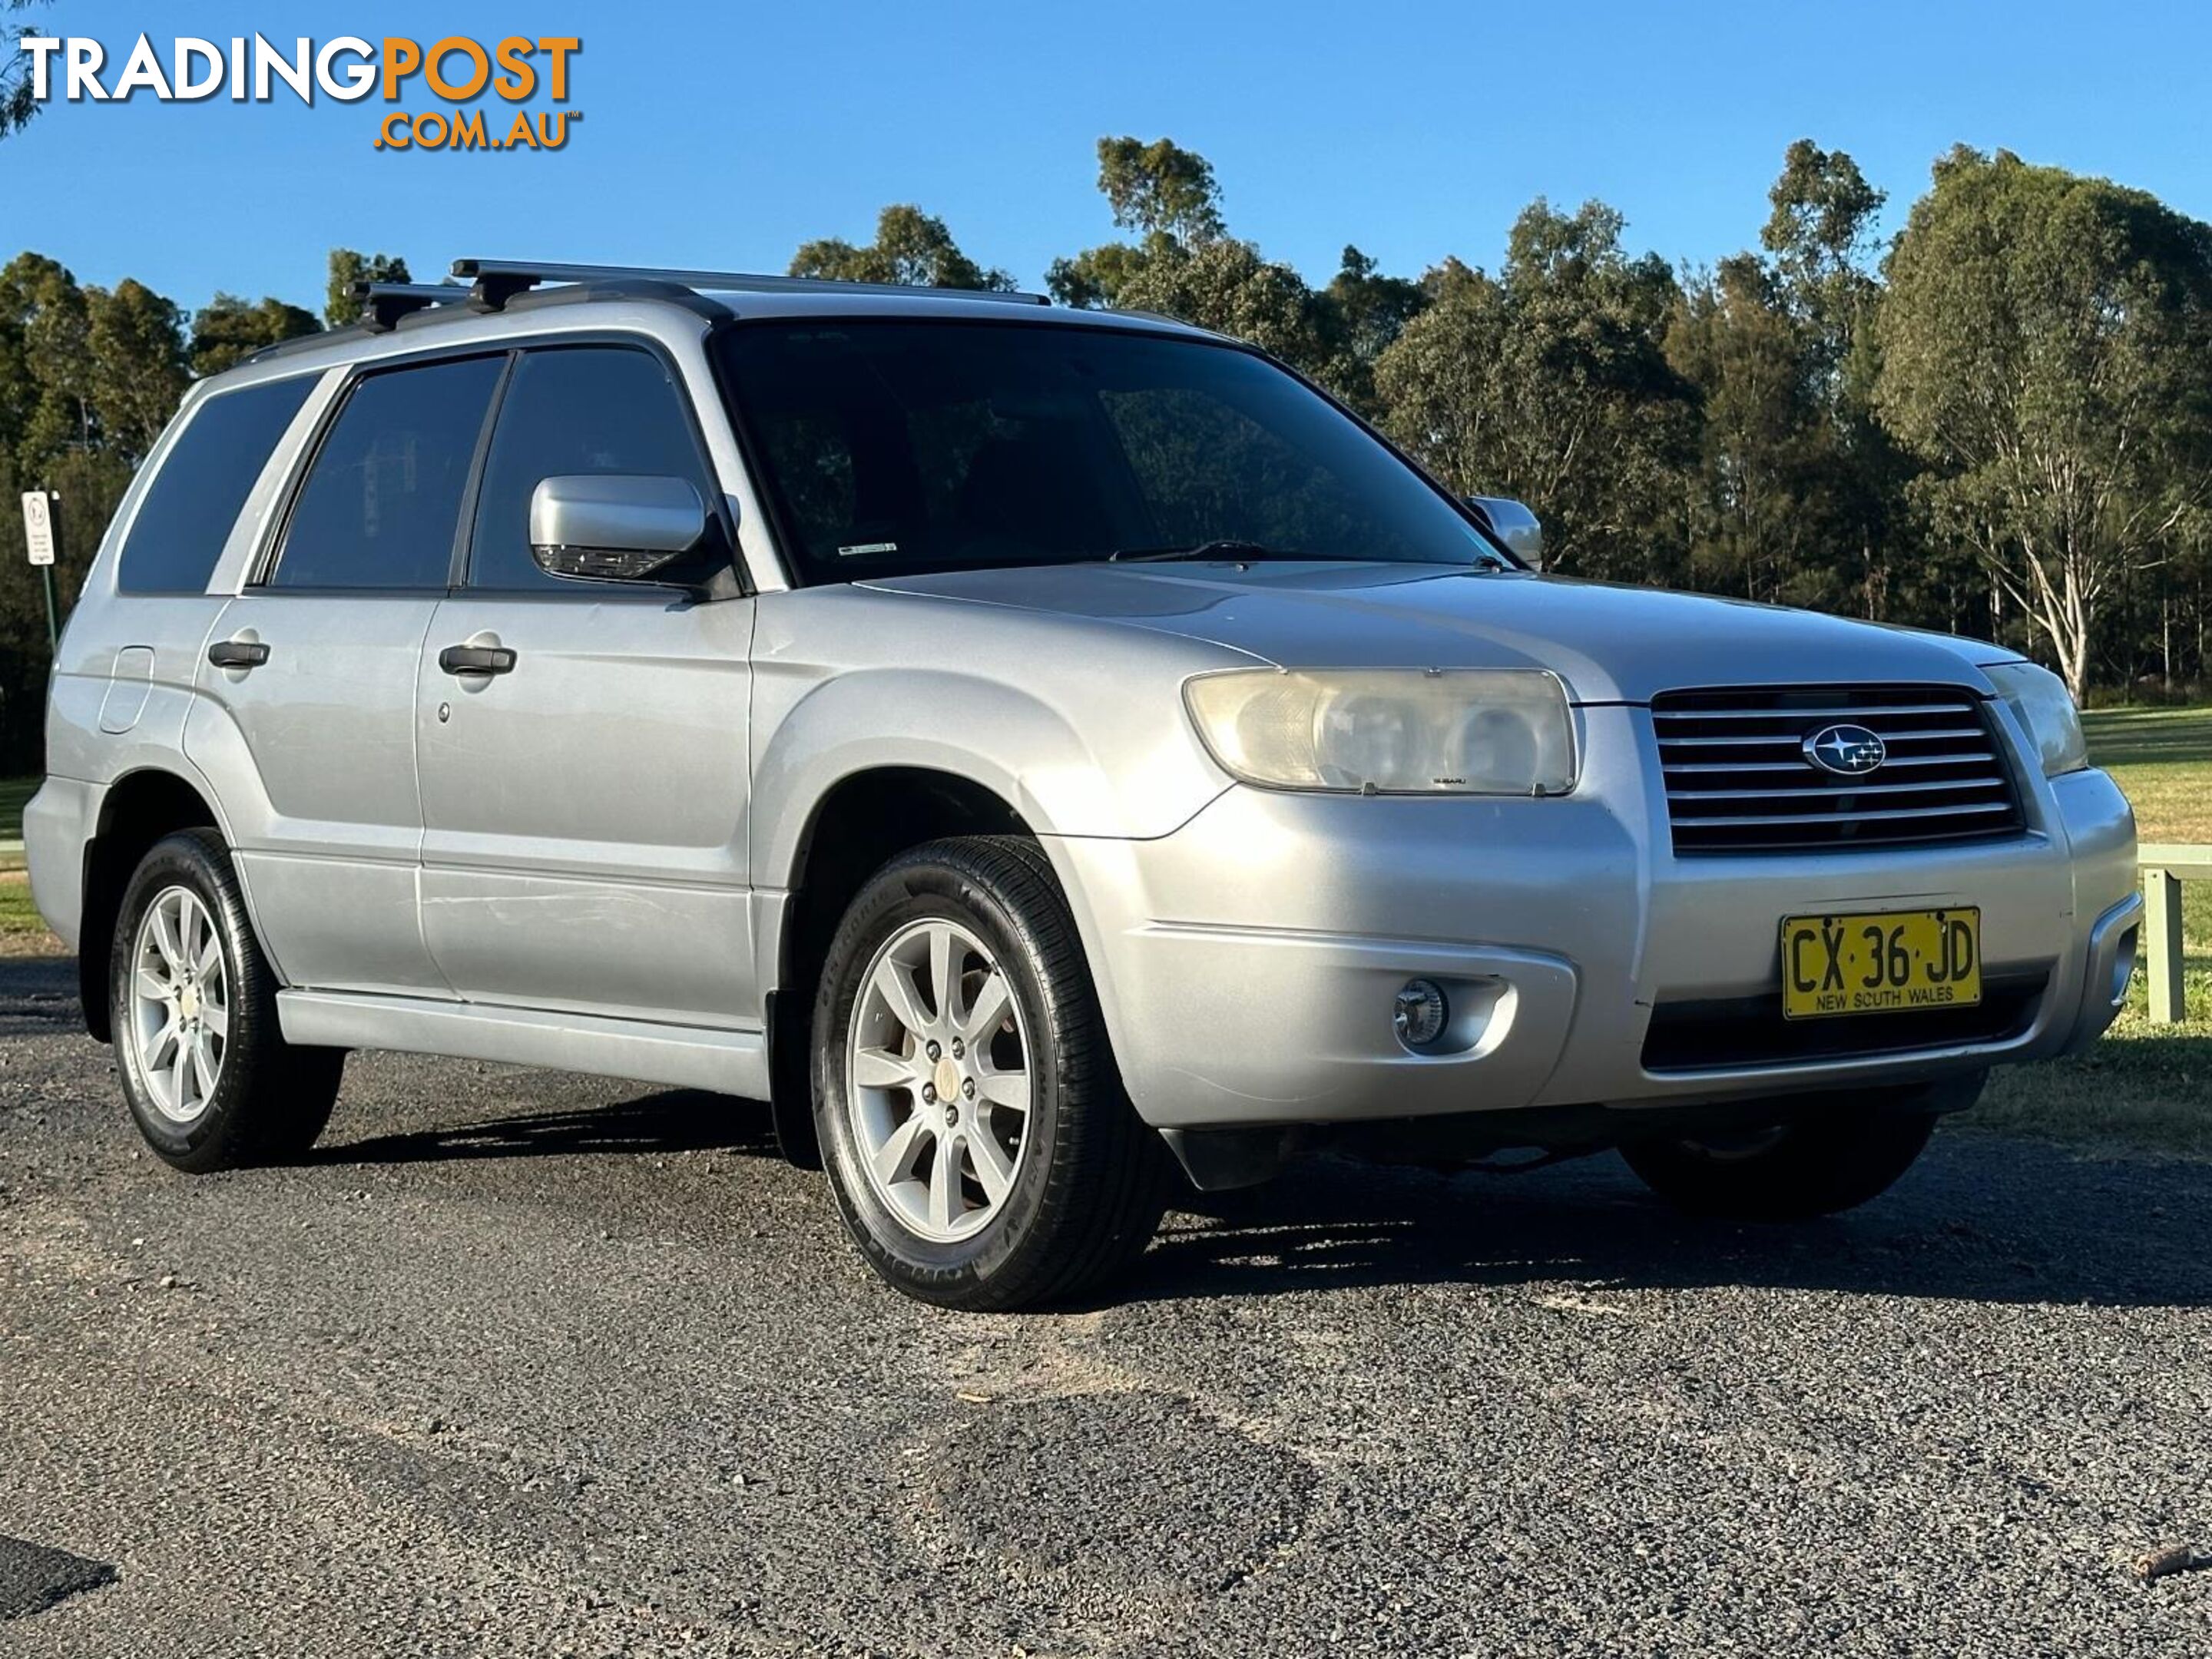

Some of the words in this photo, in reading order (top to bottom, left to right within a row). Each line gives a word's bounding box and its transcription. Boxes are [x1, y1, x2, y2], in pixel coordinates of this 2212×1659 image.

[1816, 995, 1847, 1011] NEW
[1854, 991, 1901, 1008] SOUTH
[1909, 986, 1954, 1004] WALES
